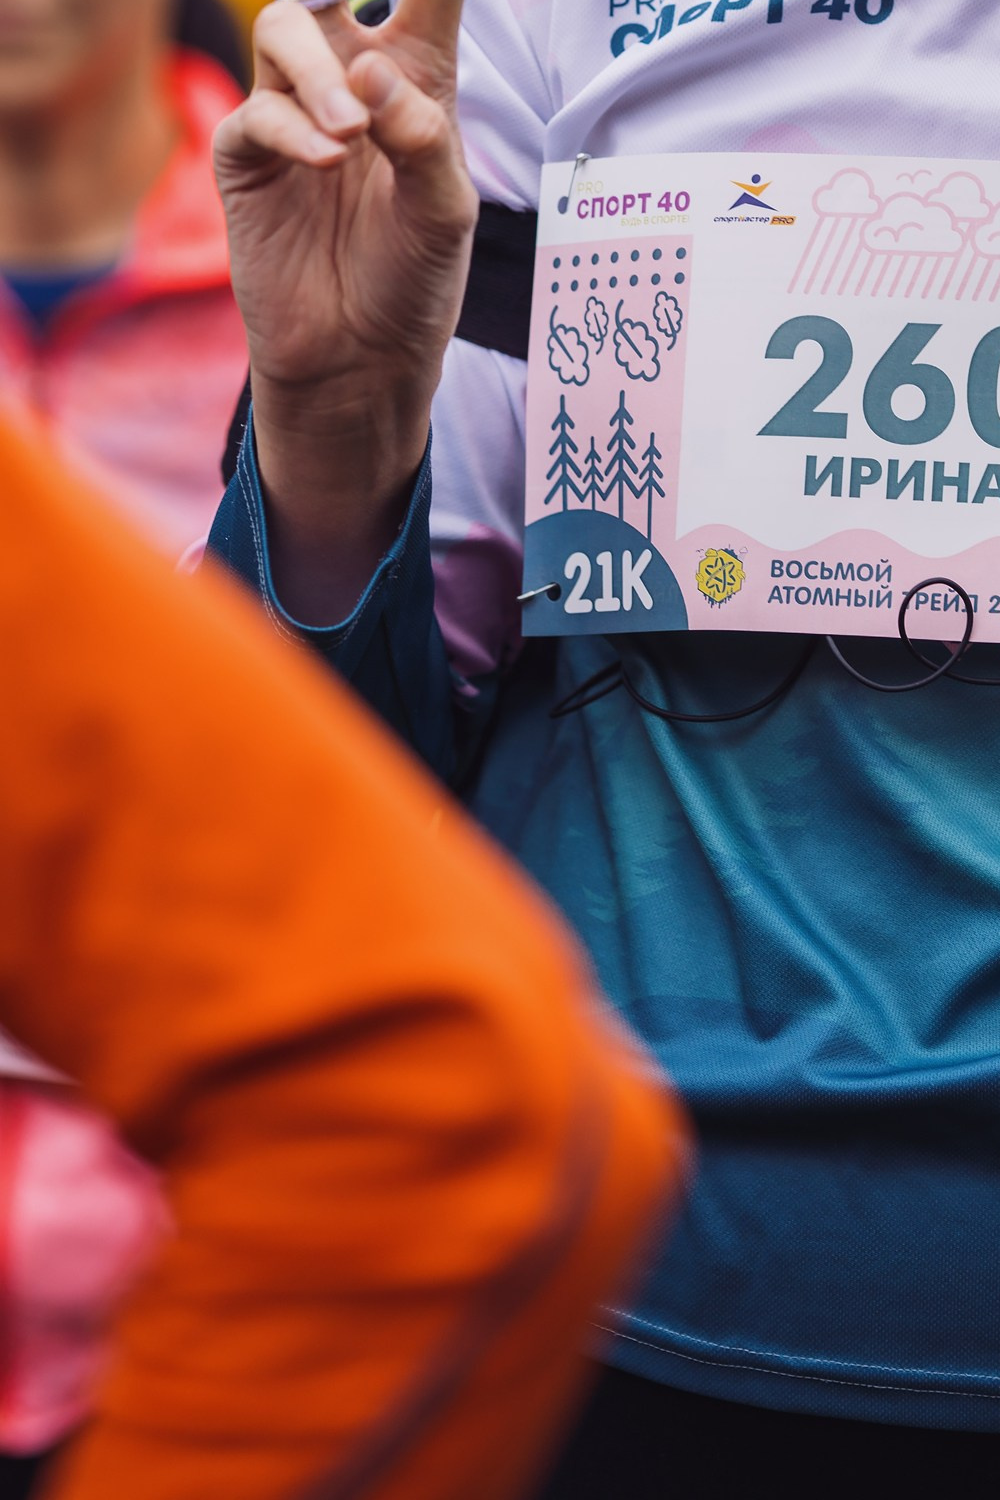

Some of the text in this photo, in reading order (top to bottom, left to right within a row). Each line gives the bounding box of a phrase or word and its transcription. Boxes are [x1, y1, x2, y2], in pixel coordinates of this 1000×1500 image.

[576, 180, 604, 194] PRO
[576, 190, 691, 219] СПОРТ 40
[620, 216, 642, 227] БУДЬ
[770, 215, 795, 225] PRO
[770, 558, 893, 583] ВОСЬМОЙ
[767, 584, 893, 609] АТОМНЫЙ
